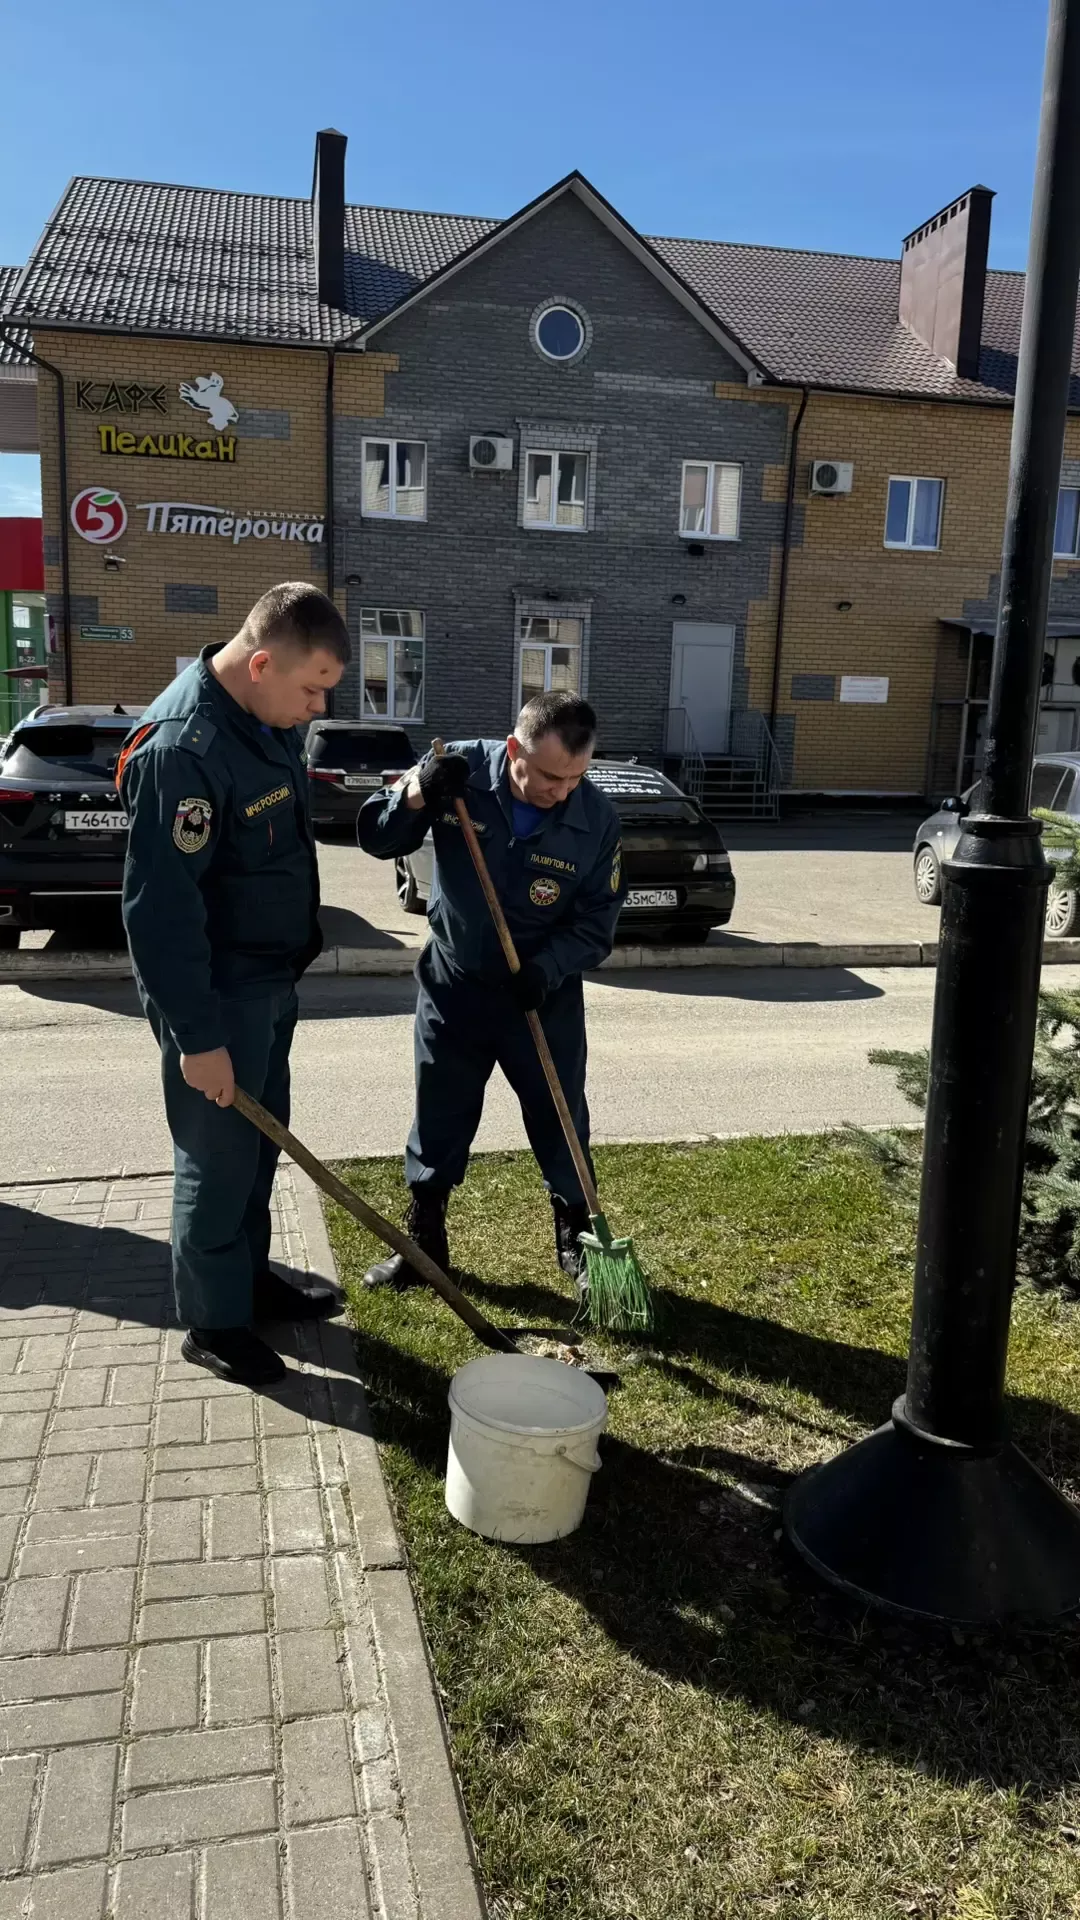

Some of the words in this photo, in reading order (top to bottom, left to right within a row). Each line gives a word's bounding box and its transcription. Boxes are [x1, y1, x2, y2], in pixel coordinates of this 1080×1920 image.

[76, 380, 168, 415] КАФЕ
[98, 425, 238, 461] Пеликан
[136, 502, 325, 544] Пятёрочка
[121, 629, 133, 639] 53
[245, 801, 262, 817] МЧС
[260, 786, 290, 809] РОССИИ
[71, 812, 129, 827] Т464ТО
